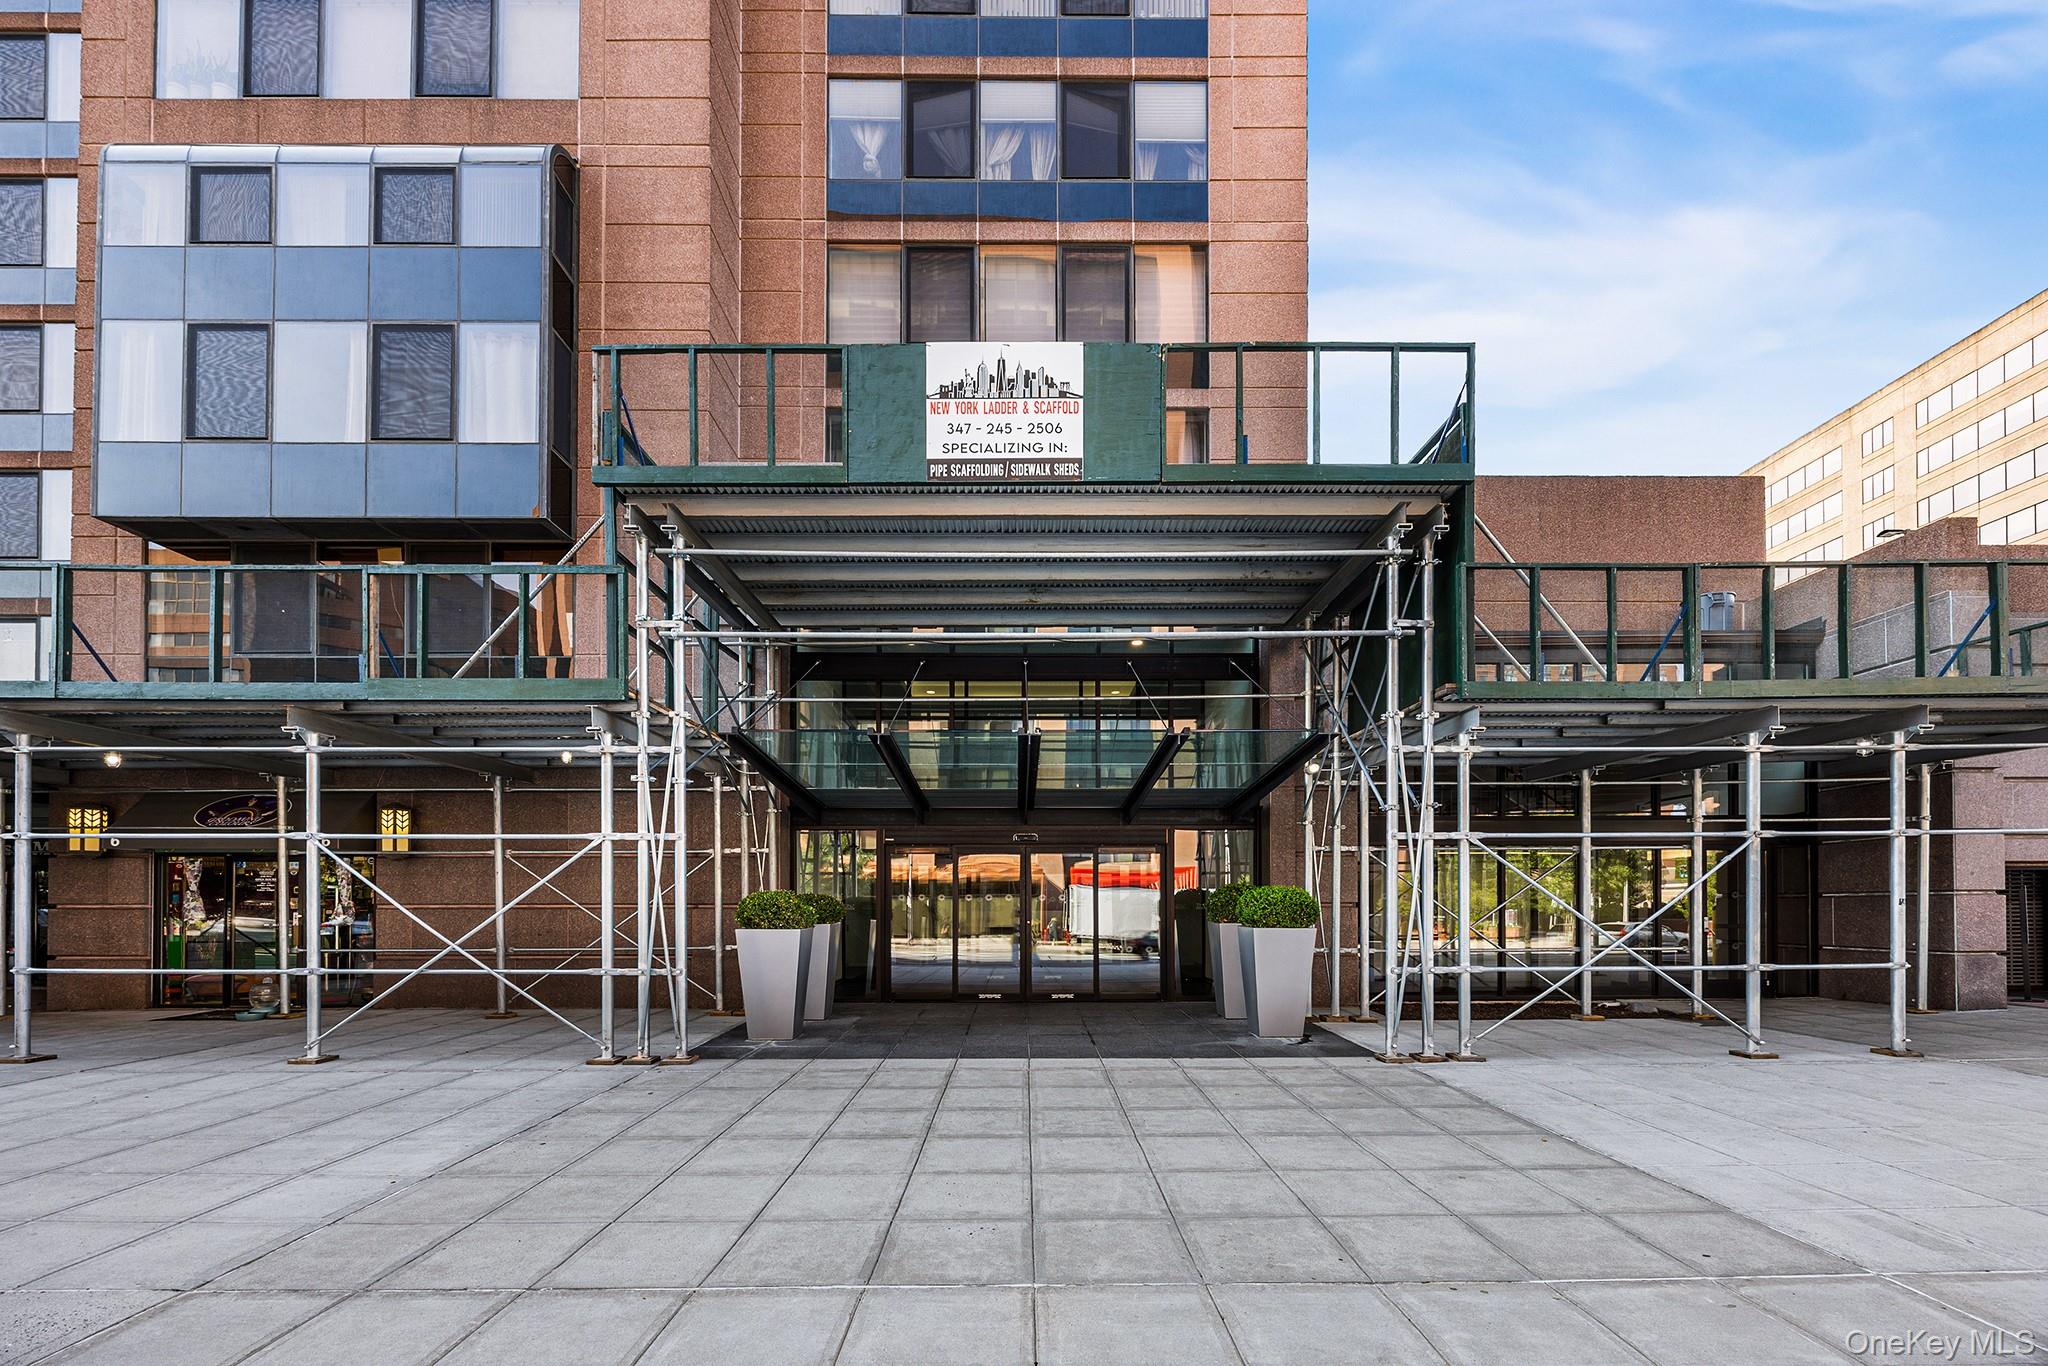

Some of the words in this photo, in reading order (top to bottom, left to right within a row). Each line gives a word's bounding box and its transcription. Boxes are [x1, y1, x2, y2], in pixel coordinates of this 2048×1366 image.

[930, 401, 950, 415] NEW
[955, 401, 979, 415] YORK
[983, 401, 1018, 415] LADDER
[1022, 401, 1029, 414] &
[1033, 401, 1080, 415] SCAFFOLD
[946, 422, 972, 435] 347
[986, 422, 1013, 435] 245
[1027, 422, 1063, 435] 2506
[942, 442, 1044, 454] SPECIALIZING
[1048, 442, 1068, 454] IN:
[930, 464, 948, 477] PIPE
[1053, 463, 1080, 476] SHEDS
